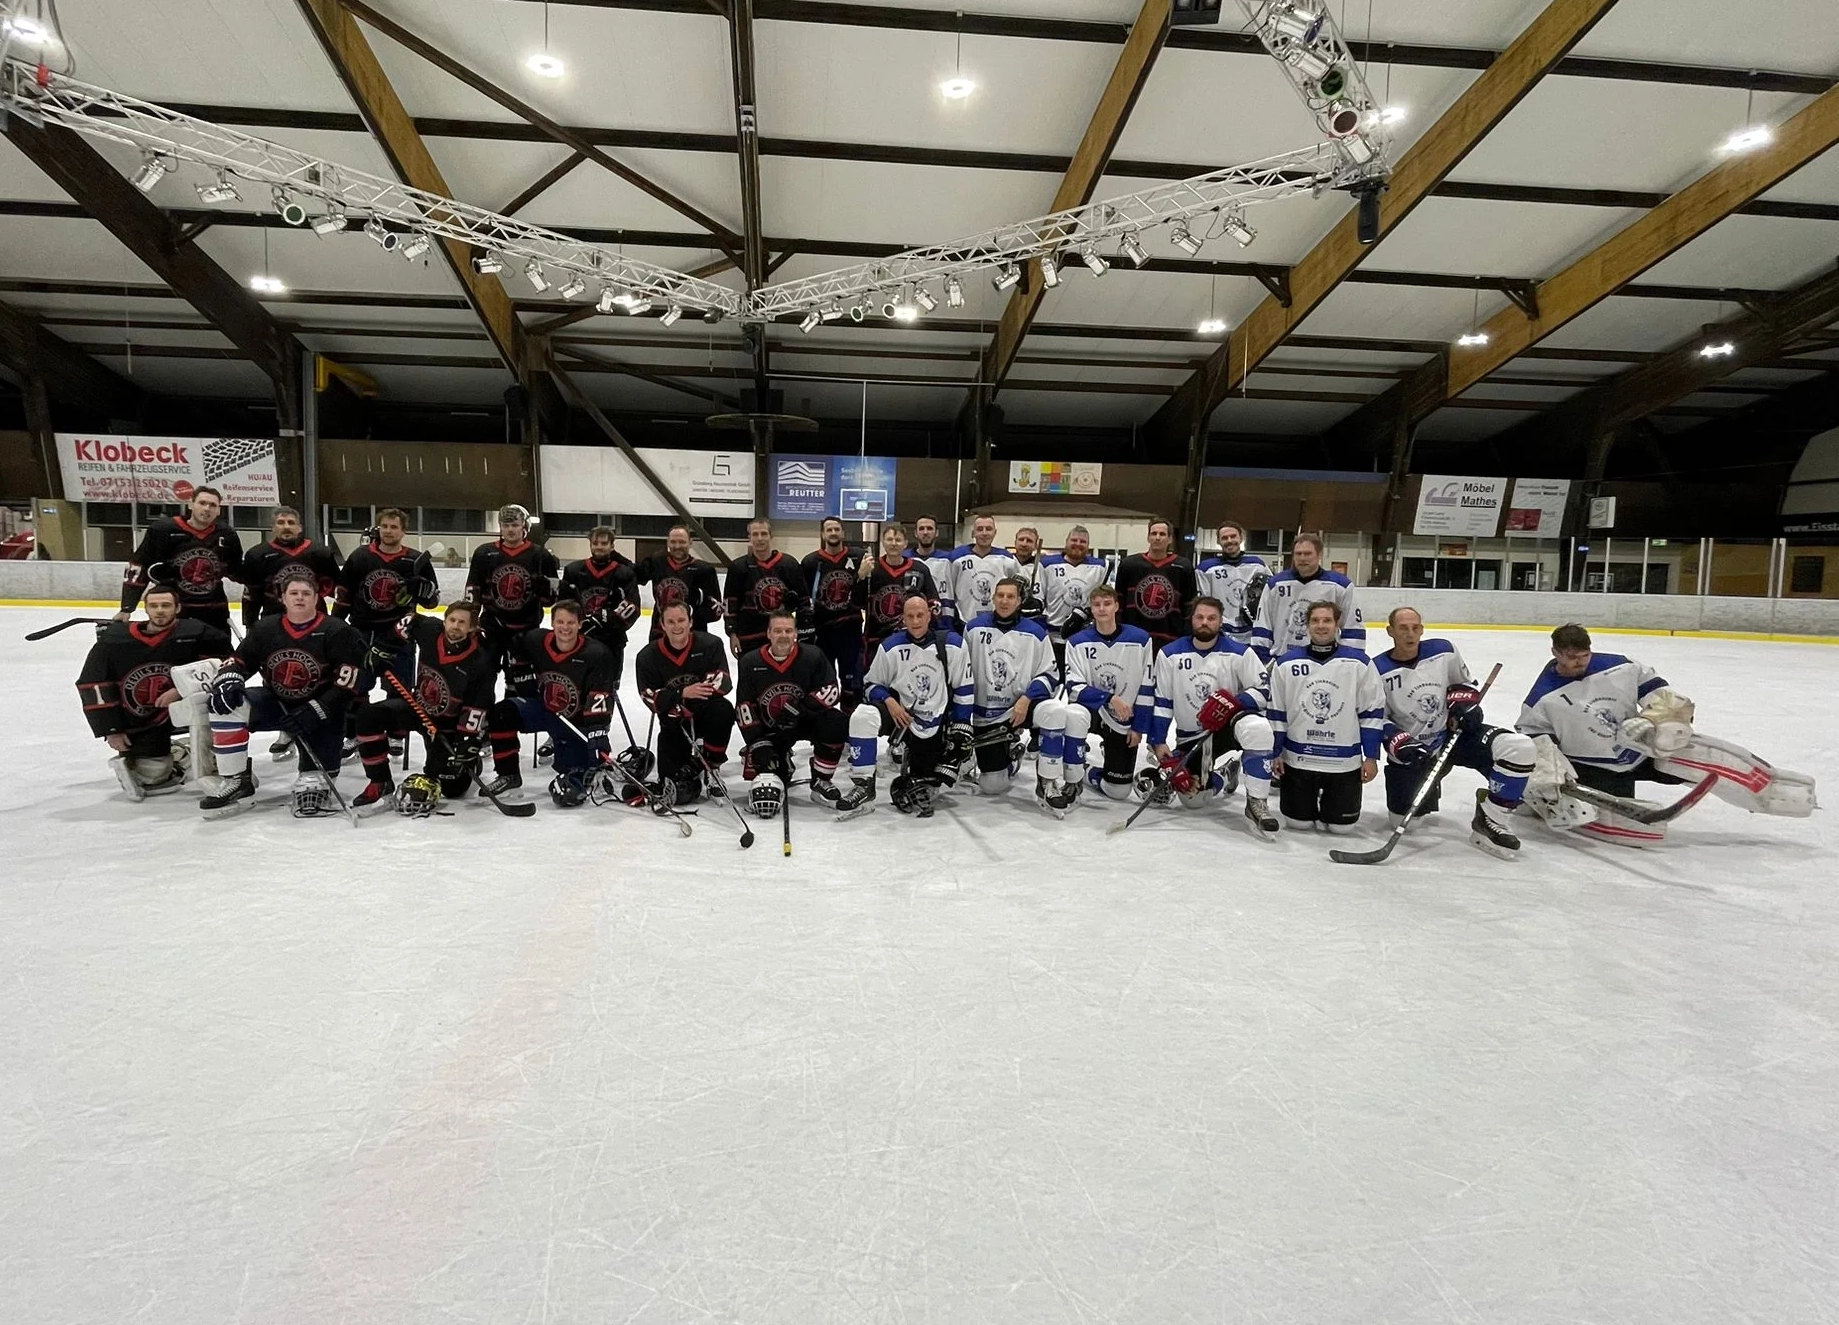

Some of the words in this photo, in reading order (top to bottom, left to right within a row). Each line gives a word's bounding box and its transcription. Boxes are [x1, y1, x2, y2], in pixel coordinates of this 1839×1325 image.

[75, 439, 189, 464] Klobeck
[78, 463, 105, 472] REIFEN
[108, 464, 114, 472] &
[116, 464, 191, 474] FAHRZEUGSERVICE
[789, 489, 825, 498] REUTTER
[1463, 482, 1495, 493] Möbel
[1461, 496, 1497, 506] Mathes
[962, 559, 974, 571] 20
[1054, 567, 1065, 577] 13
[1214, 569, 1228, 580] 53
[1278, 585, 1291, 598] 91
[980, 631, 992, 644] 78
[899, 649, 910, 661] 17
[1085, 647, 1097, 659] 12
[1291, 664, 1309, 676] 60
[336, 665, 359, 689] 91
[1386, 674, 1402, 691] 77
[590, 693, 609, 713] 21
[1560, 693, 1573, 706] 1
